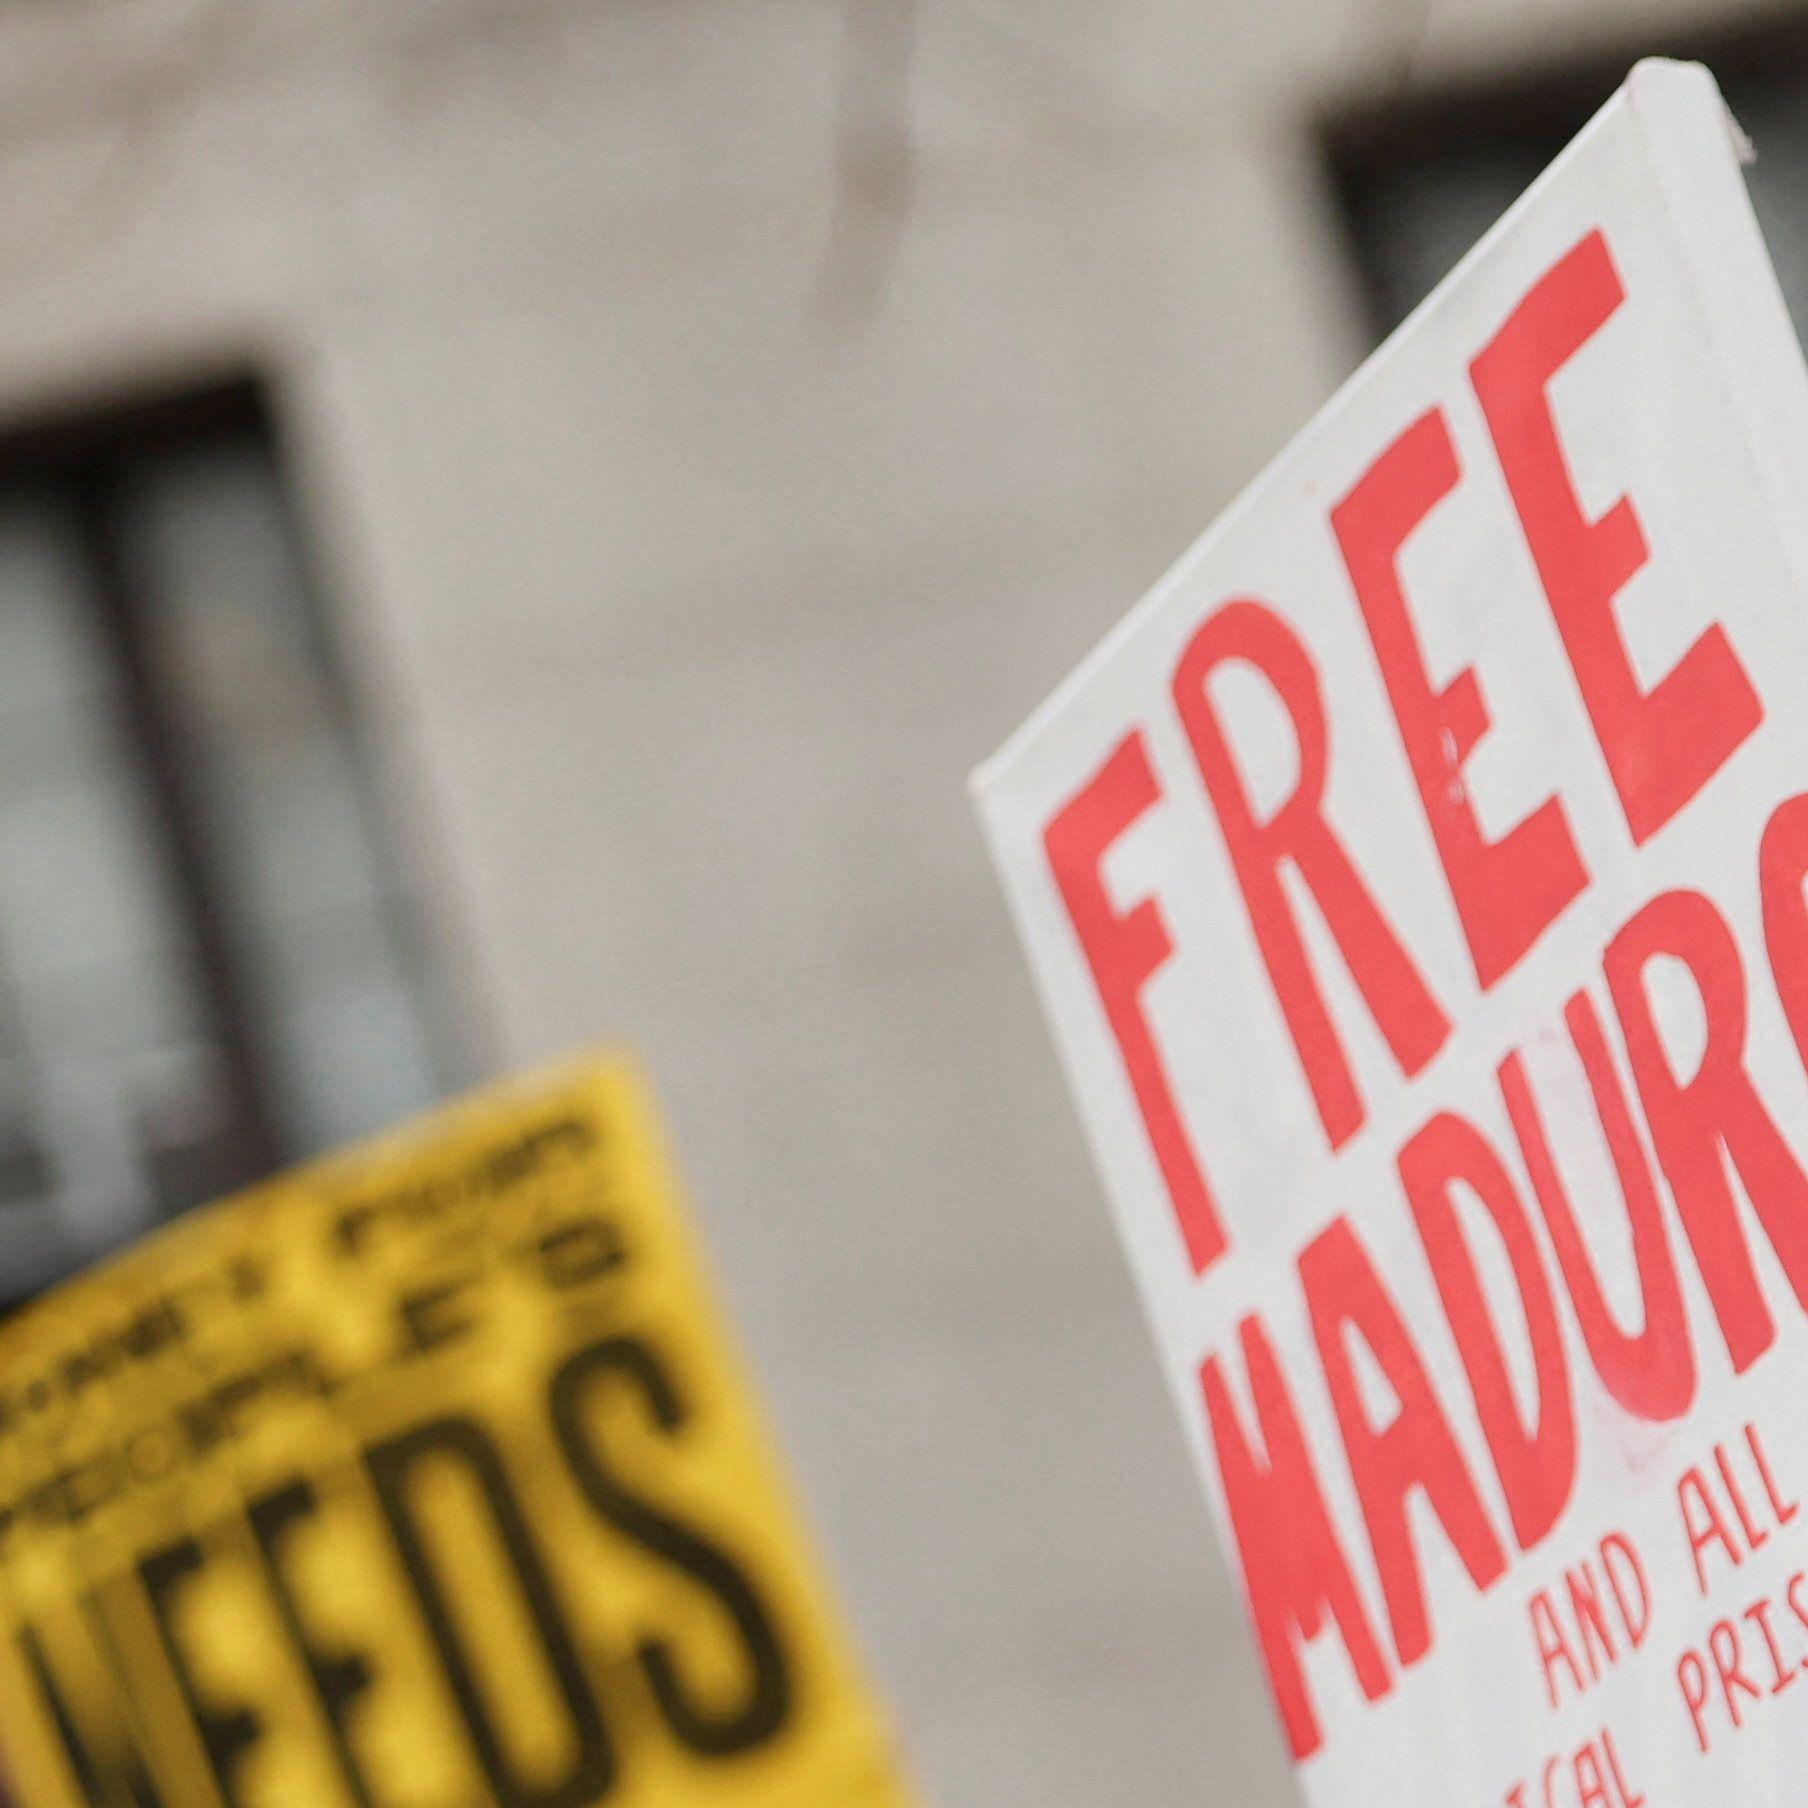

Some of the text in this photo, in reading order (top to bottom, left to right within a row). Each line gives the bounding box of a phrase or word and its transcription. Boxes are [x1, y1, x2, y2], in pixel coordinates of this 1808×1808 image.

[1042, 226, 1765, 1278] FREE
[1528, 1424, 1798, 1708] AND ALL
